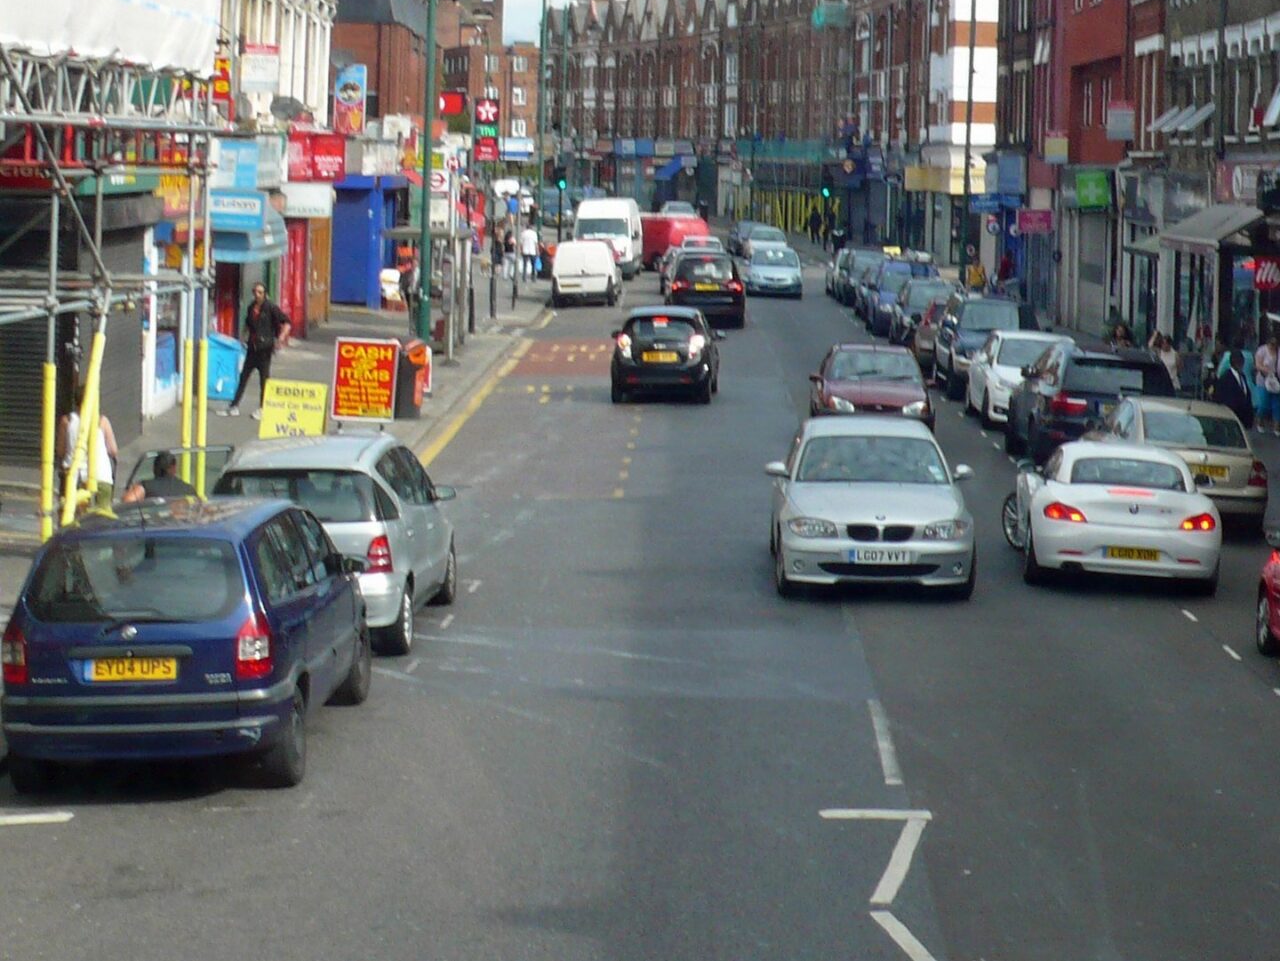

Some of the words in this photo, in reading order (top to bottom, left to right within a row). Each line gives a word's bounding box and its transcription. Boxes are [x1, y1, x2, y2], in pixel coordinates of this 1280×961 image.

[340, 344, 393, 361] CASH
[340, 367, 391, 383] ITEMS
[856, 550, 885, 561] LG07
[887, 550, 906, 562] VVT
[95, 657, 136, 676] EY04
[140, 657, 172, 676] UPS
